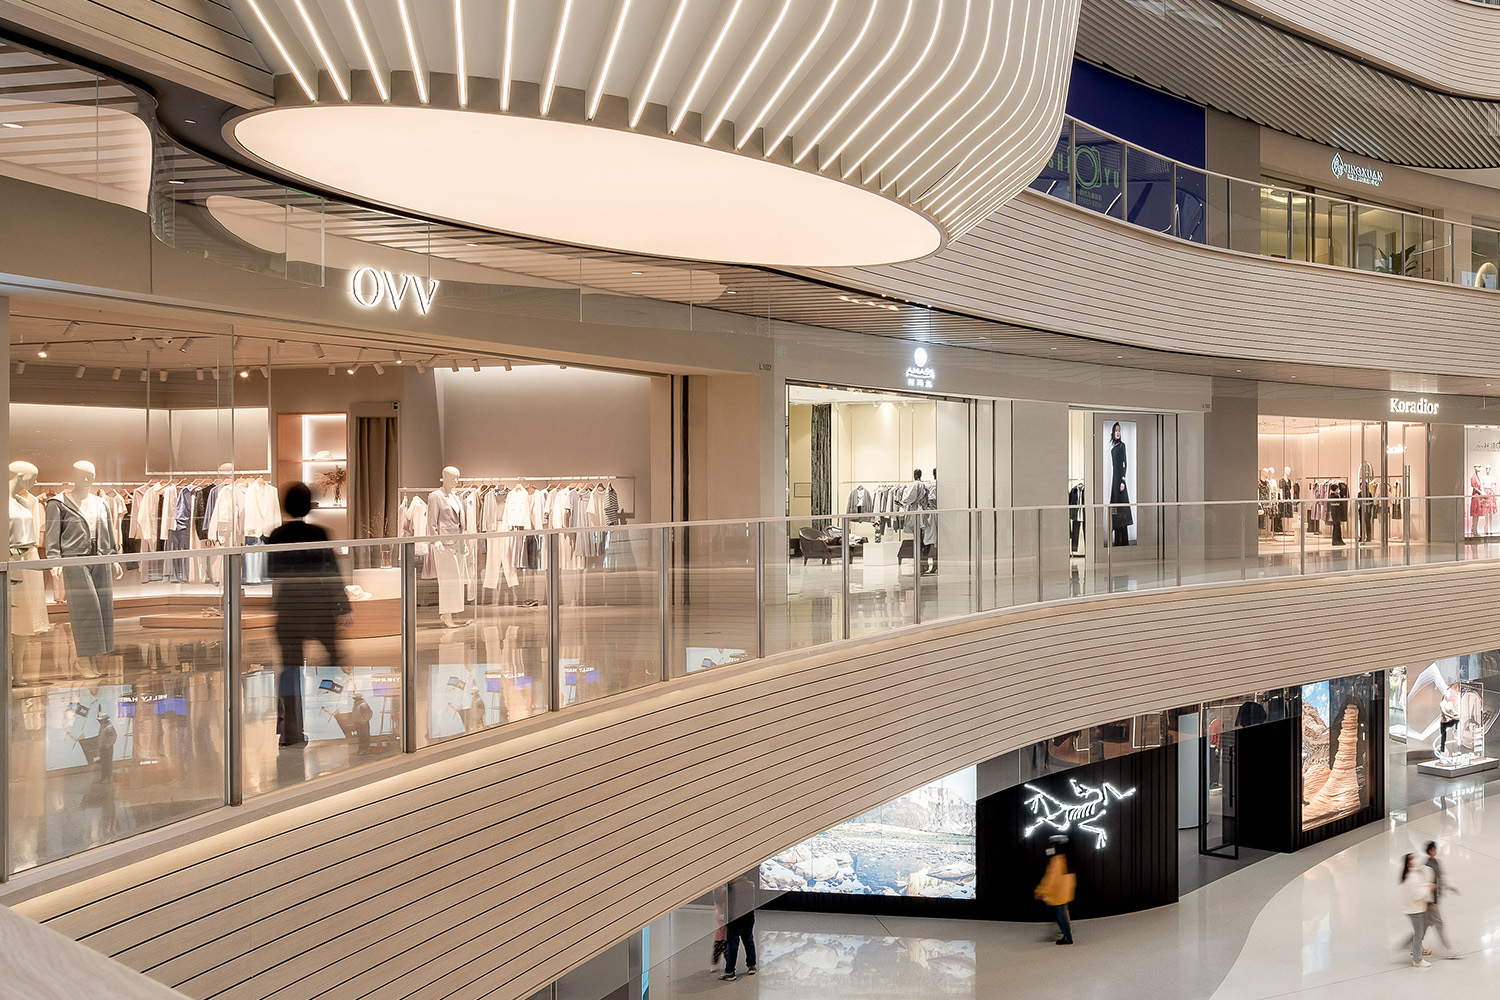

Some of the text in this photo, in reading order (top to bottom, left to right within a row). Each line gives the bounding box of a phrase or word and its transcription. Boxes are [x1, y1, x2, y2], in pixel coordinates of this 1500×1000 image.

[1104, 167, 1119, 189] YU
[1343, 162, 1384, 182] JINGXUAN
[350, 266, 441, 316] OVV
[1389, 397, 1440, 415] Koradior
